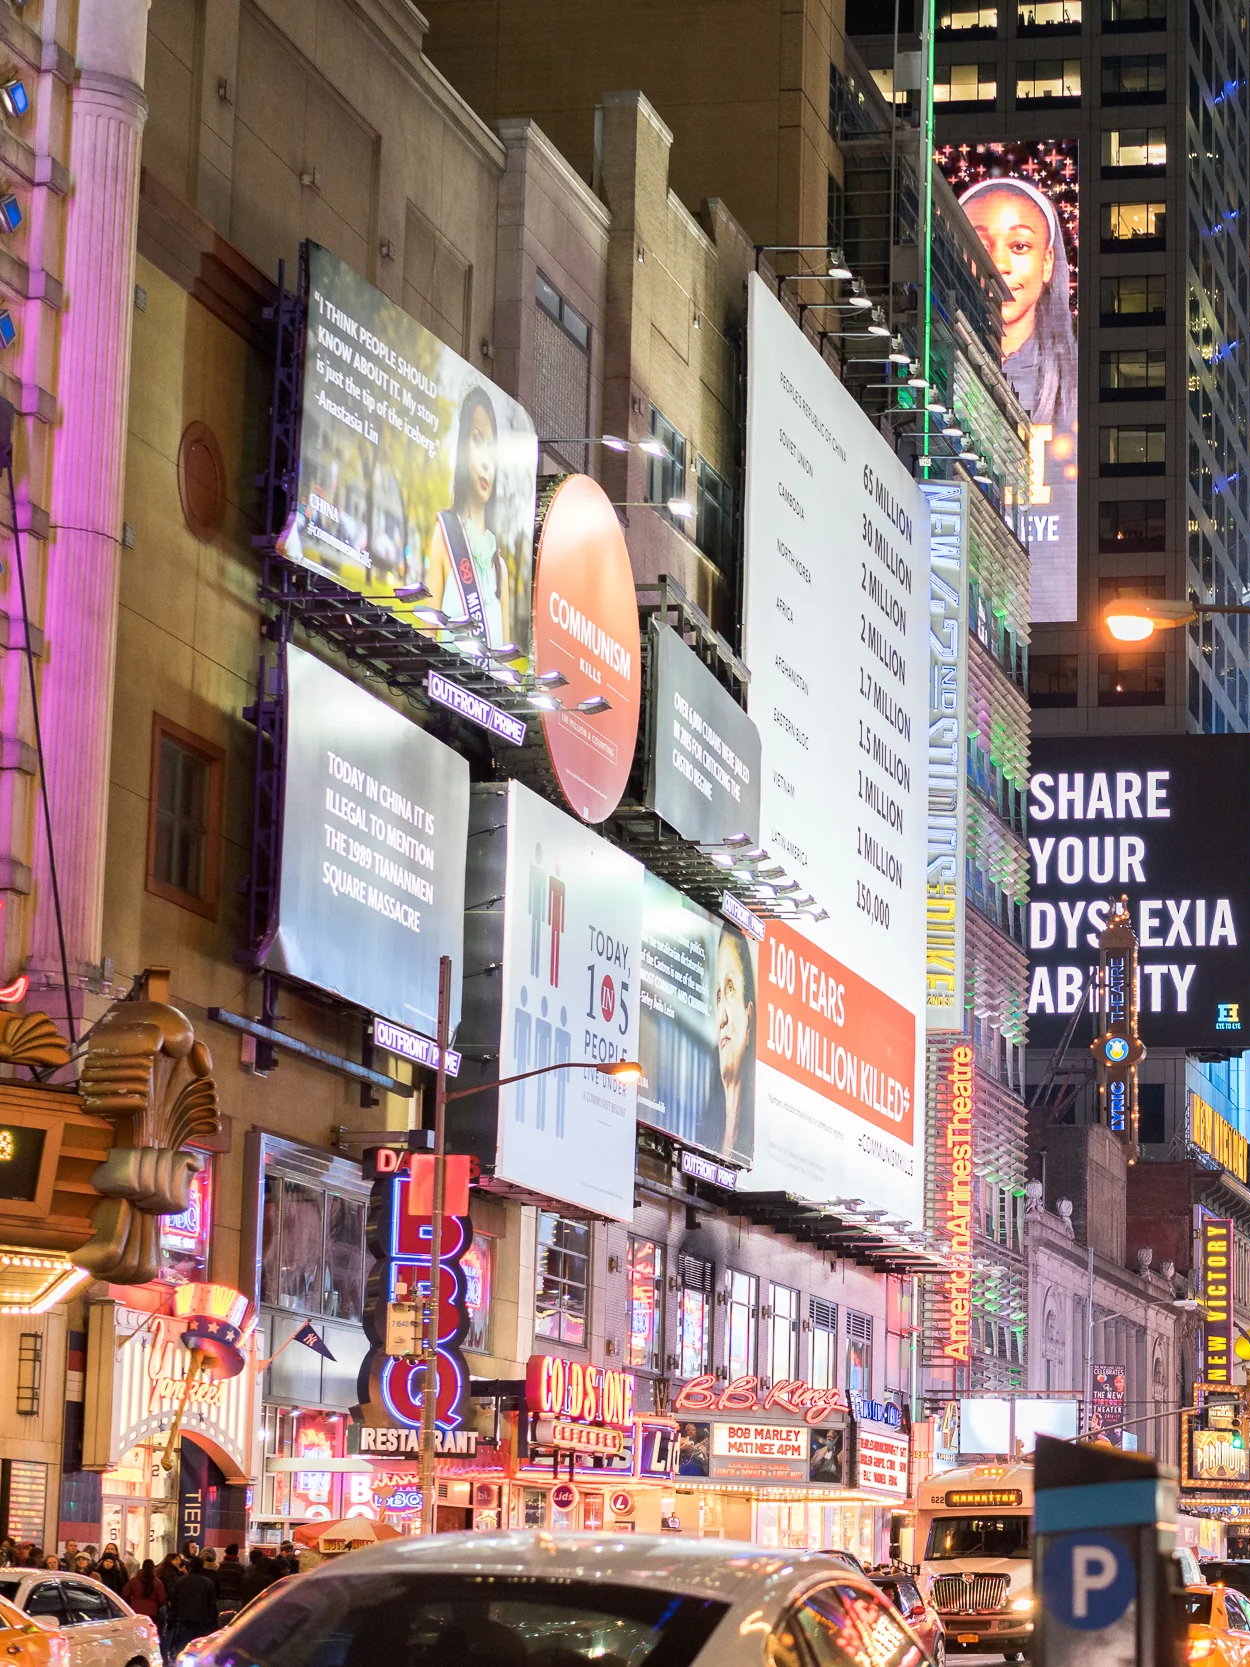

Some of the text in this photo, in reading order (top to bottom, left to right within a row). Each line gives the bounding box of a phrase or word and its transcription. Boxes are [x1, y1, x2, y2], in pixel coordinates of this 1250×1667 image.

[325, 300, 437, 399] THINK PEOPLE SHOULD
[316, 353, 402, 430] is just the tip of the
[318, 324, 440, 432] KNOW ABOUT My story
[364, 420, 378, 445] Lin
[778, 428, 814, 480] SOVIET UNION
[802, 399, 848, 464] REPUBLIC CHINA
[310, 493, 339, 523] CHINA
[778, 482, 805, 522] CAMBODIA
[863, 464, 912, 546] 65 MILLION
[306, 521, 372, 568] #communismkills
[862, 513, 912, 595] 30 MILLION
[776, 596, 794, 624] AFRICA
[868, 570, 906, 636] MILLION
[549, 592, 632, 682] COMMUNISM
[868, 622, 906, 686] MILLION
[580, 657, 602, 685] KILLS
[774, 654, 809, 696] AFGHANISTAN
[432, 677, 523, 743] OUTFRONT PRIME
[773, 707, 796, 741] EASTERN
[860, 666, 912, 743] 1.7 MILLION
[592, 734, 615, 758] COUNTING
[702, 722, 750, 784] CUBANS JAILED
[858, 718, 910, 794] 1.5 MILLION
[327, 750, 435, 836] TODAY IN CHINA IT IS
[672, 748, 714, 802] CASTRO REGIME
[772, 769, 796, 799] VIETNAM
[1029, 771, 1171, 821] SHARE
[326, 787, 435, 871] ILLEGAL TO MENTION
[864, 776, 904, 836] MILLION
[324, 823, 434, 906] THE 1989 TIANANMEN
[864, 833, 903, 890] MILLION
[1028, 836, 1146, 884] YOUR
[322, 861, 421, 934] SQUARE MASSACRE
[856, 880, 890, 930] 150,000
[1030, 899, 1238, 950] DYSEXIA
[588, 924, 632, 978] TODAY,
[586, 964, 630, 1036] 1 IN 5
[768, 936, 846, 1028] 100 YEARS
[1028, 964, 1196, 1014] ABITY
[378, 1024, 430, 1061] OUTFRONT
[584, 1030, 628, 1063] PEOPLE
[766, 1002, 858, 1098] 100 MILLION
[1110, 957, 1125, 1131] LYRIC THEATRE
[683, 1155, 736, 1188] OUTFRONT PRIME
[1208, 1225, 1228, 1382] NEW VICTORY
[1094, 1368, 1124, 1376] CELEBRATES
[1094, 1390, 1124, 1400] THE NEW
[675, 1374, 759, 1412] B.B.
[764, 1380, 850, 1424] King
[1092, 1406, 1122, 1414] THEATER
[361, 1428, 480, 1455] RESTARANT
[554, 1424, 621, 1450] CREAMERY
[728, 1426, 801, 1443] BOB MARLEY
[728, 1442, 802, 1456] MATINEE 4PM
[1196, 1440, 1246, 1474] PARAMOUR
[768, 1463, 792, 1472] GRILL
[184, 1488, 202, 1537] TIER
[554, 1492, 574, 1502] Lids
[930, 1494, 1017, 1504] 622 MANHATTAN
[1072, 1544, 1118, 1618] P
